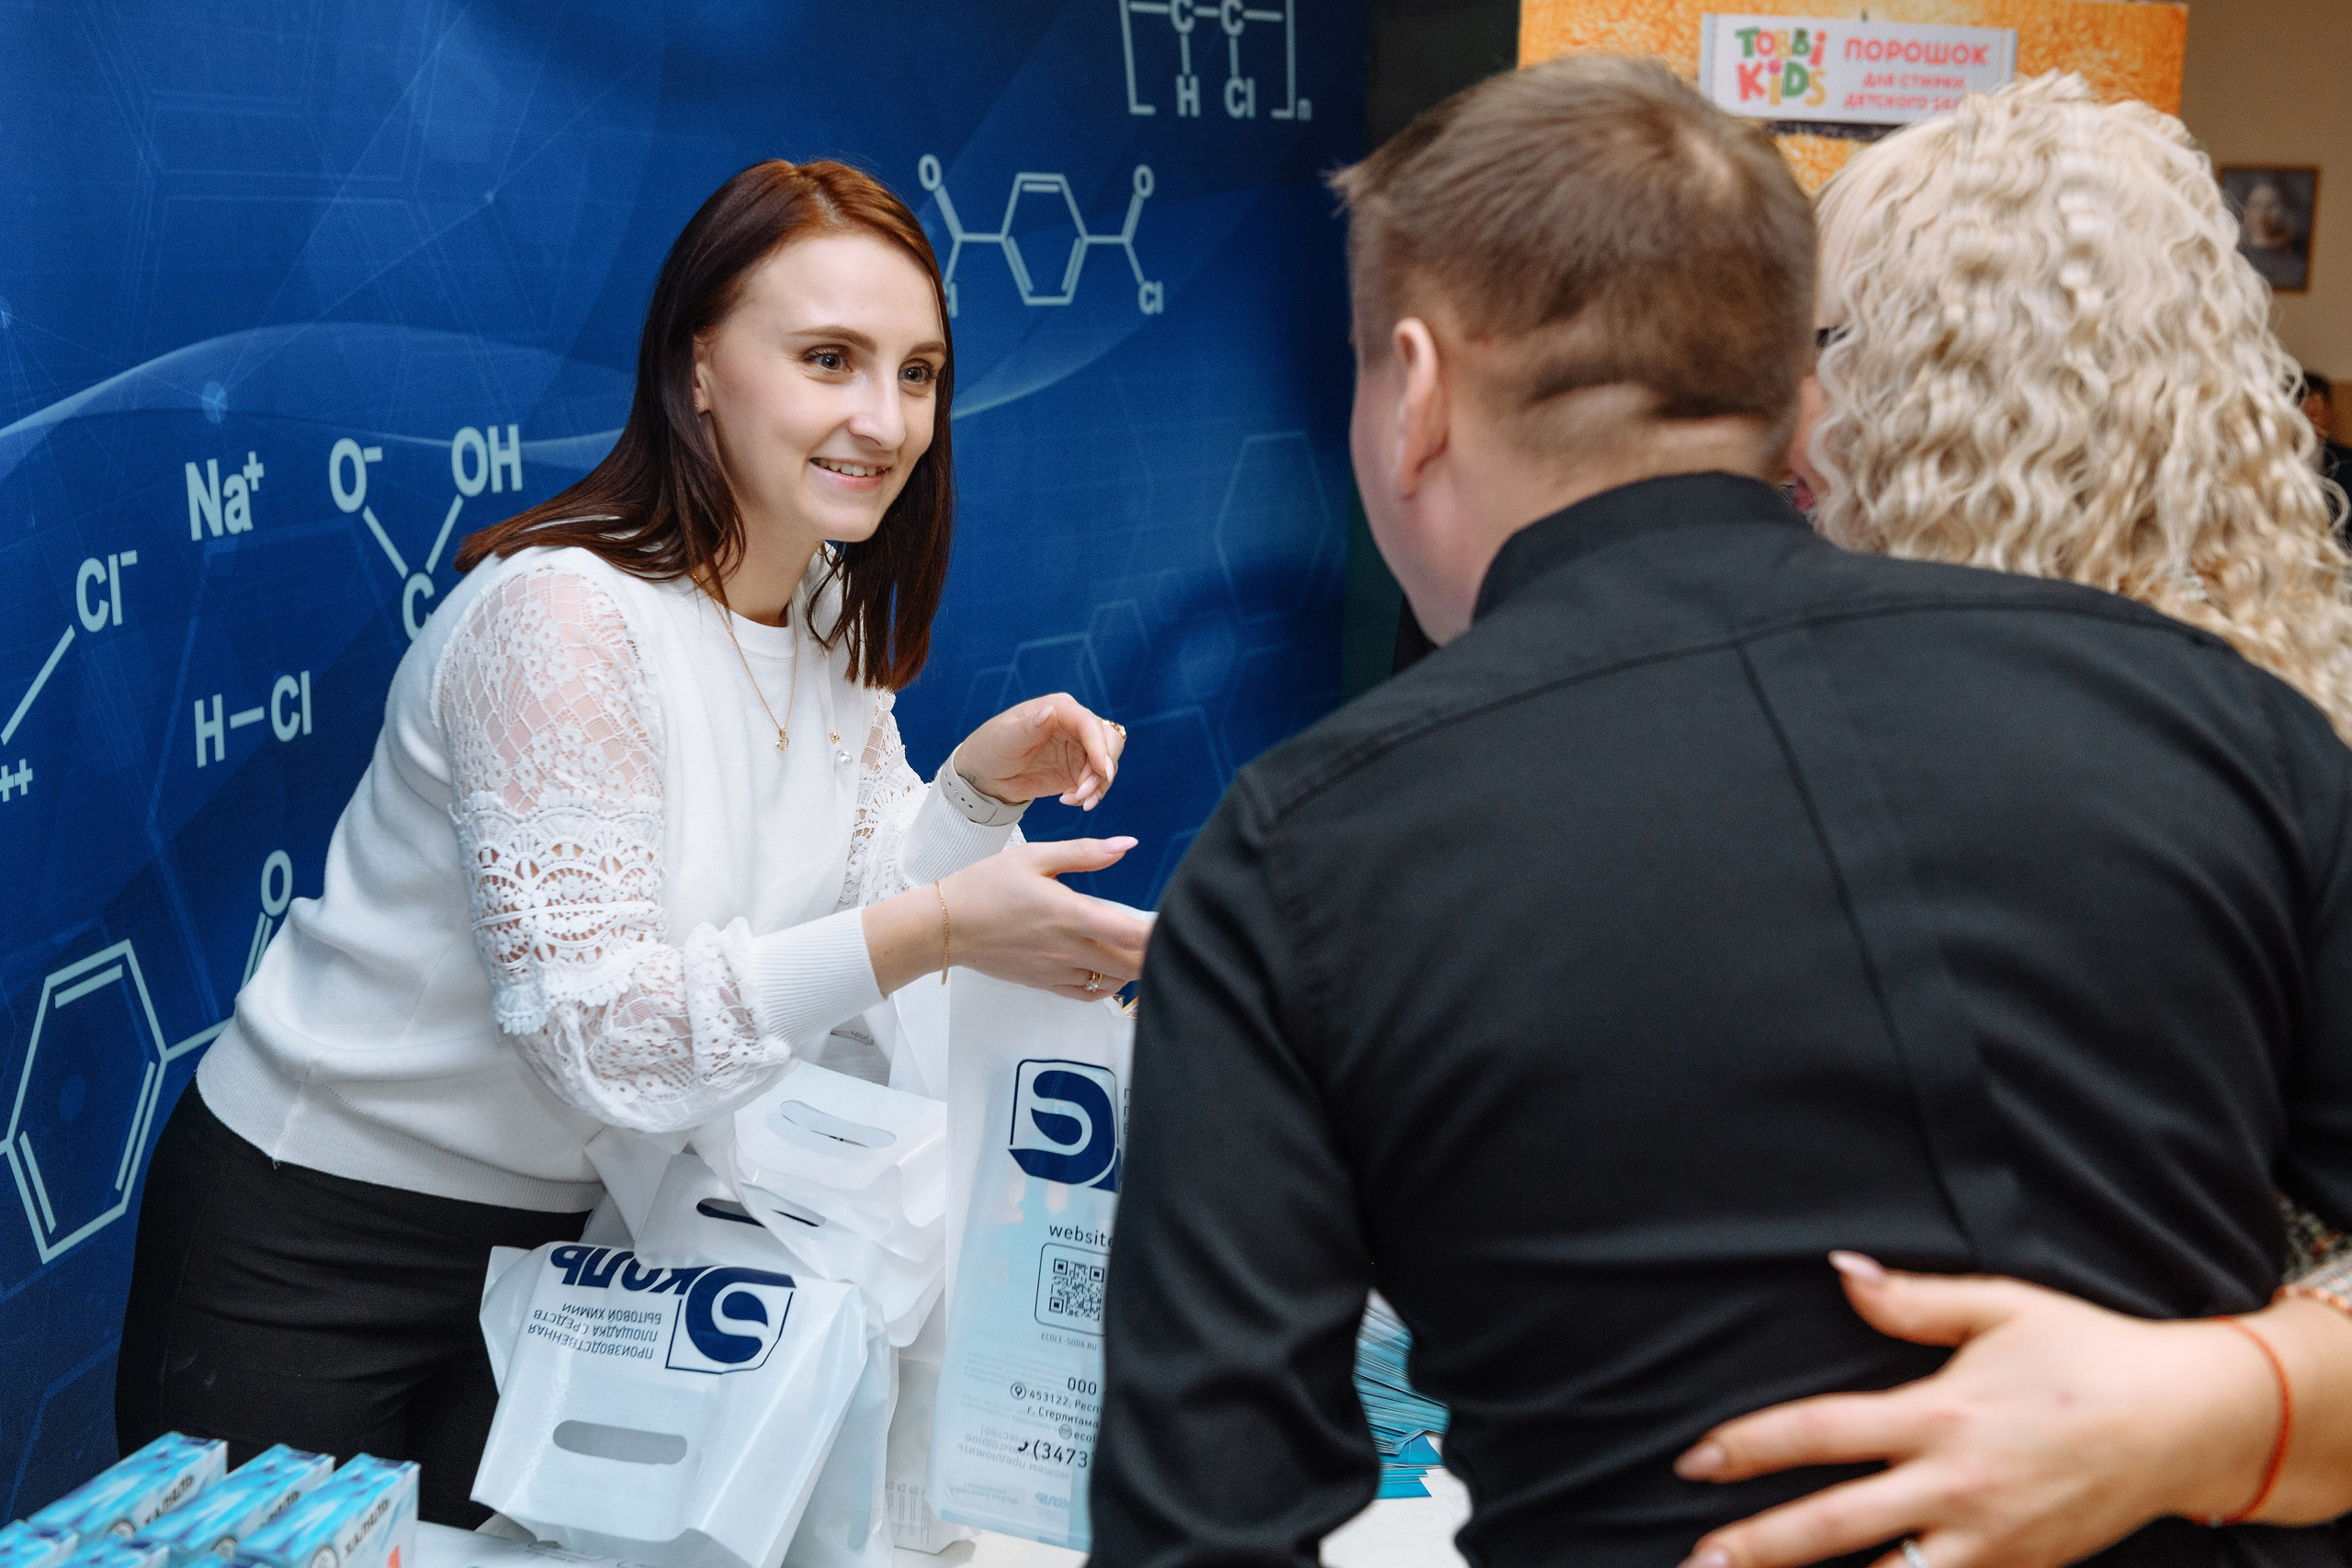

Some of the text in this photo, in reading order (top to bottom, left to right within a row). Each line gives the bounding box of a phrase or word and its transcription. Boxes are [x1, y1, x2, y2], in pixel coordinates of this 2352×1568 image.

[1844, 37, 1991, 67] ПОРОШОК
[1861, 72, 1966, 90] ДЛЯ СТИРКИ
[1176, 75, 1256, 118] H Cl
[1843, 93, 1928, 110] ДЕТСКОГО
[1138, 280, 1165, 315] Cl
[451, 424, 524, 497] OH
[1049, 1224, 1114, 1249] website
[533, 1309, 659, 1342] ПЛОЩАДКА СРЕДСТВ
[562, 1303, 662, 1325] БЫТОВОЙ ХИМИИ
[527, 1323, 654, 1359] ПРОИЗВОДСТВЕННАЯ
[1041, 1332, 1097, 1351] ECOLE-SODA.RU
[1029, 1390, 1071, 1408] 453122,
